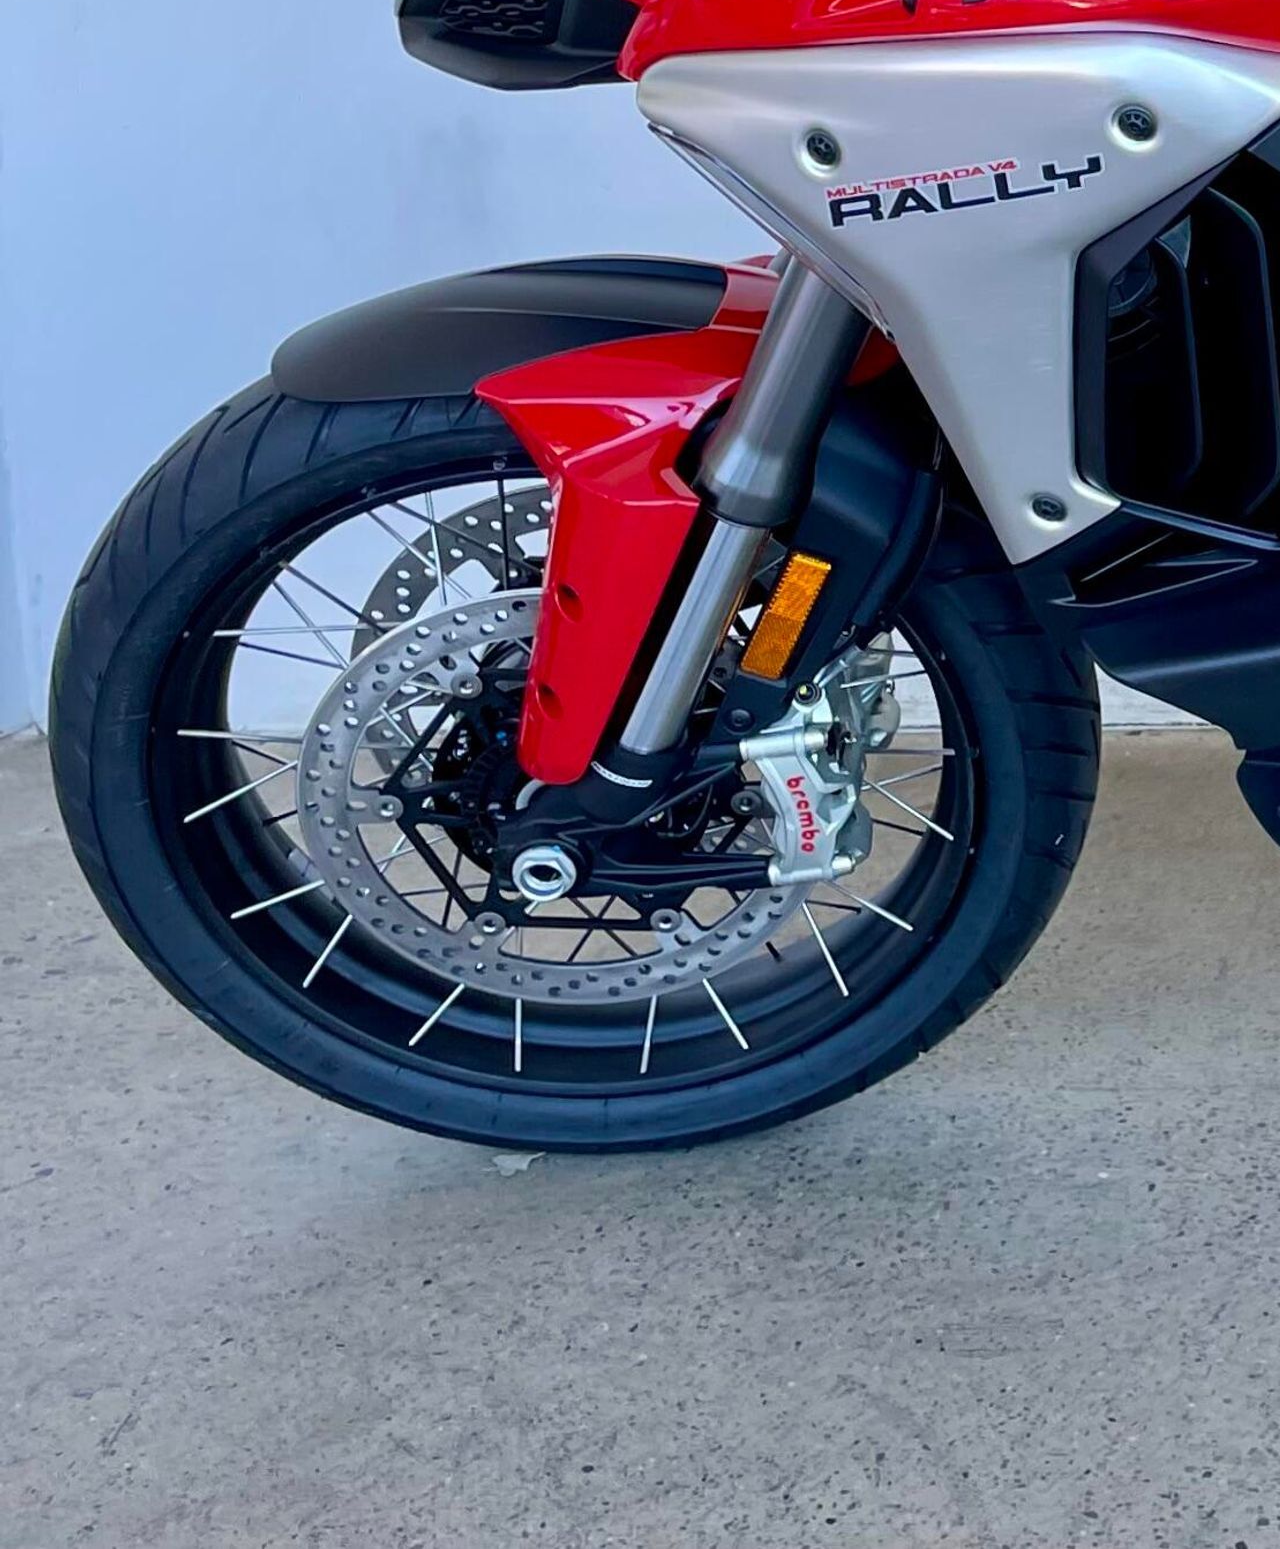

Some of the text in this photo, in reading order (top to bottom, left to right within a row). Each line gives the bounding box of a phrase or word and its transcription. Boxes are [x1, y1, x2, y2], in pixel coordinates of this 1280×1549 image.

[827, 160, 1017, 199] MULTISTRADA V4
[829, 155, 1101, 227] RALLY
[787, 776, 820, 852] brembo
